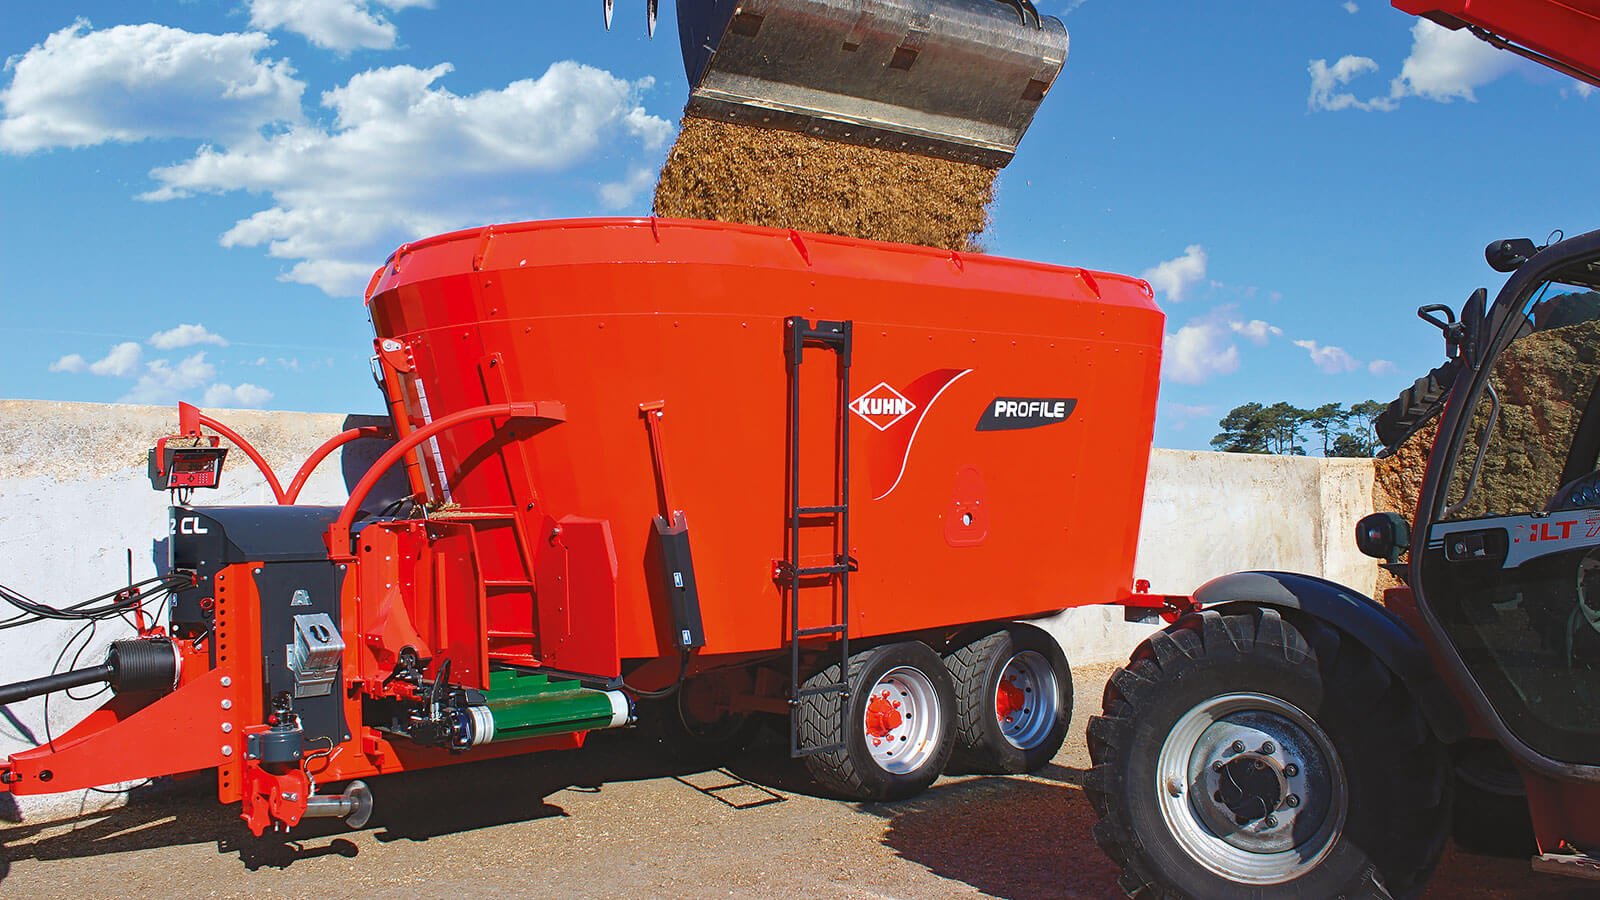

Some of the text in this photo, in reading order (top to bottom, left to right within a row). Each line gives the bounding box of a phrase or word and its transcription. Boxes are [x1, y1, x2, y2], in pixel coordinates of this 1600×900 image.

[858, 397, 906, 415] KUHN
[994, 400, 1066, 418] PROFILE
[180, 516, 209, 535] CL
